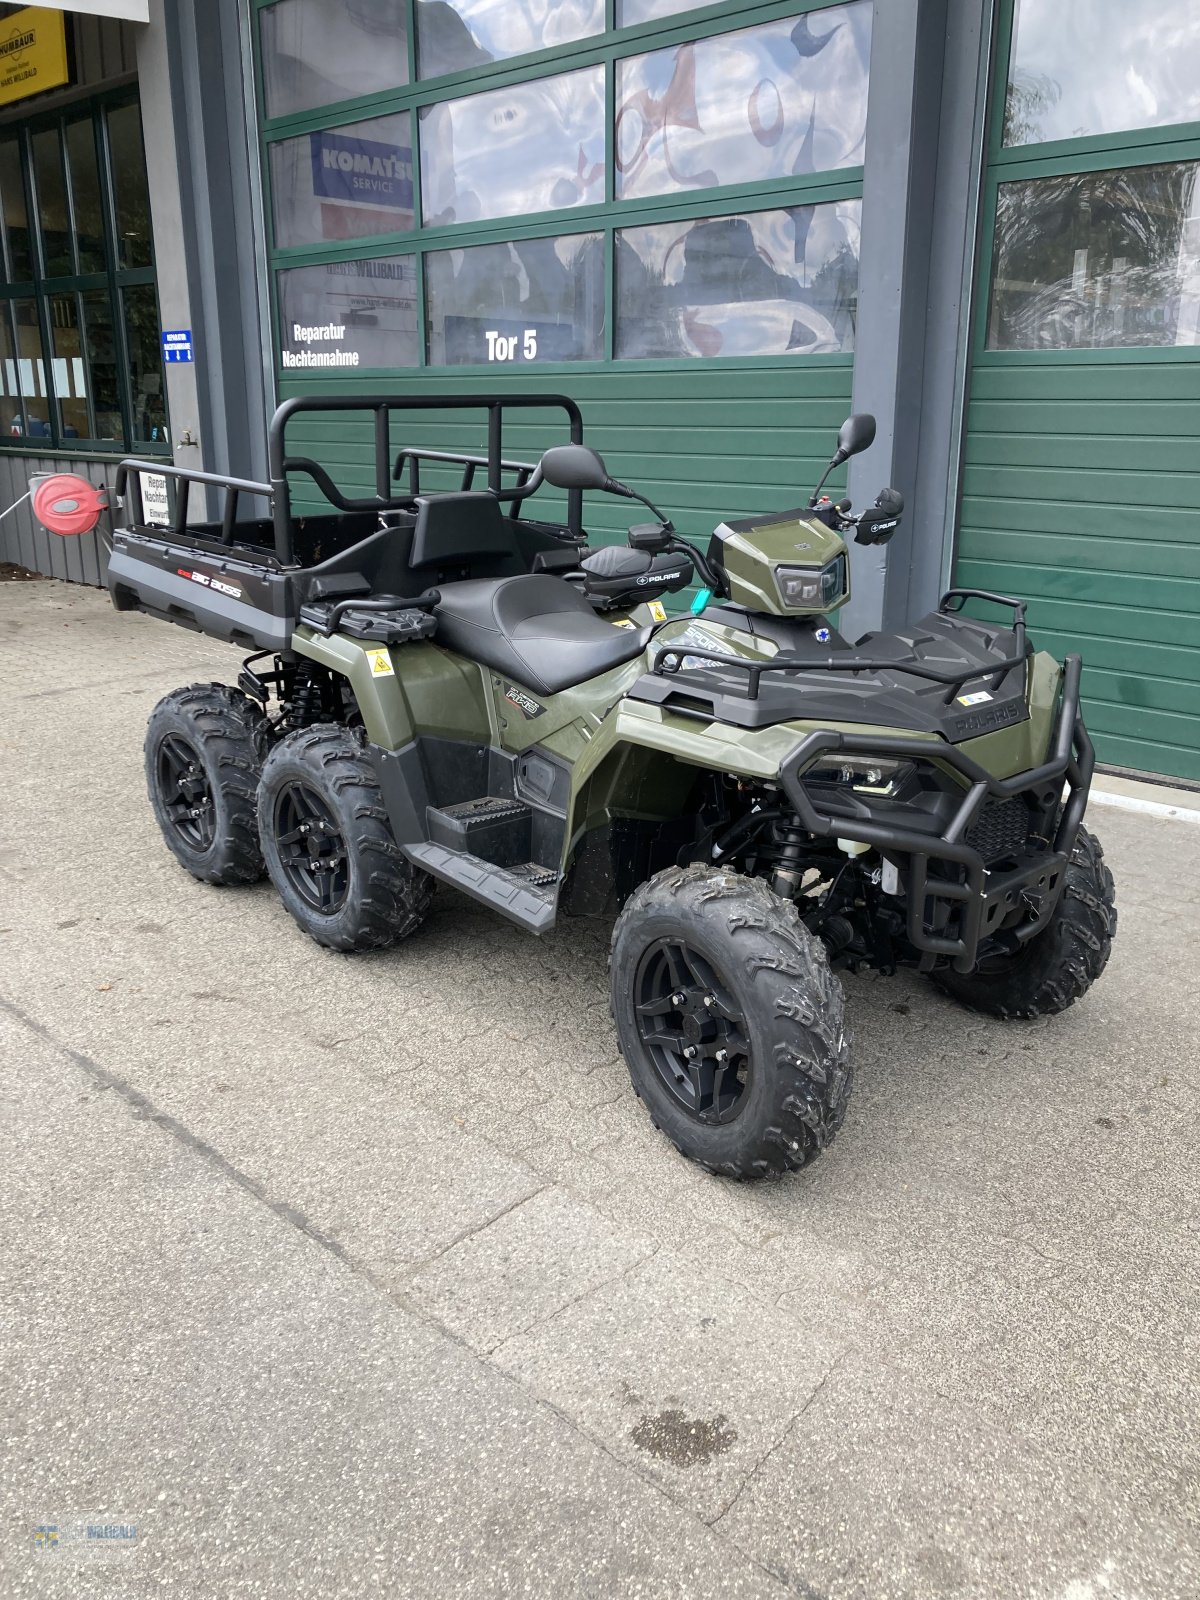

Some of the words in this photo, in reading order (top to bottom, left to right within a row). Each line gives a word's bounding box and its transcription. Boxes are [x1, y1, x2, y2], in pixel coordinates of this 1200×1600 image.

[352, 176, 394, 193] SERVICE
[293, 322, 346, 345] Reparatur
[485, 331, 518, 361] Tor
[523, 329, 537, 360] 5
[282, 348, 359, 368] Nachtannahme
[879, 519, 898, 531] POLARIS
[648, 571, 681, 583] POLARIS
[209, 578, 242, 598] BOSS
[955, 703, 1019, 733] POLARIS
